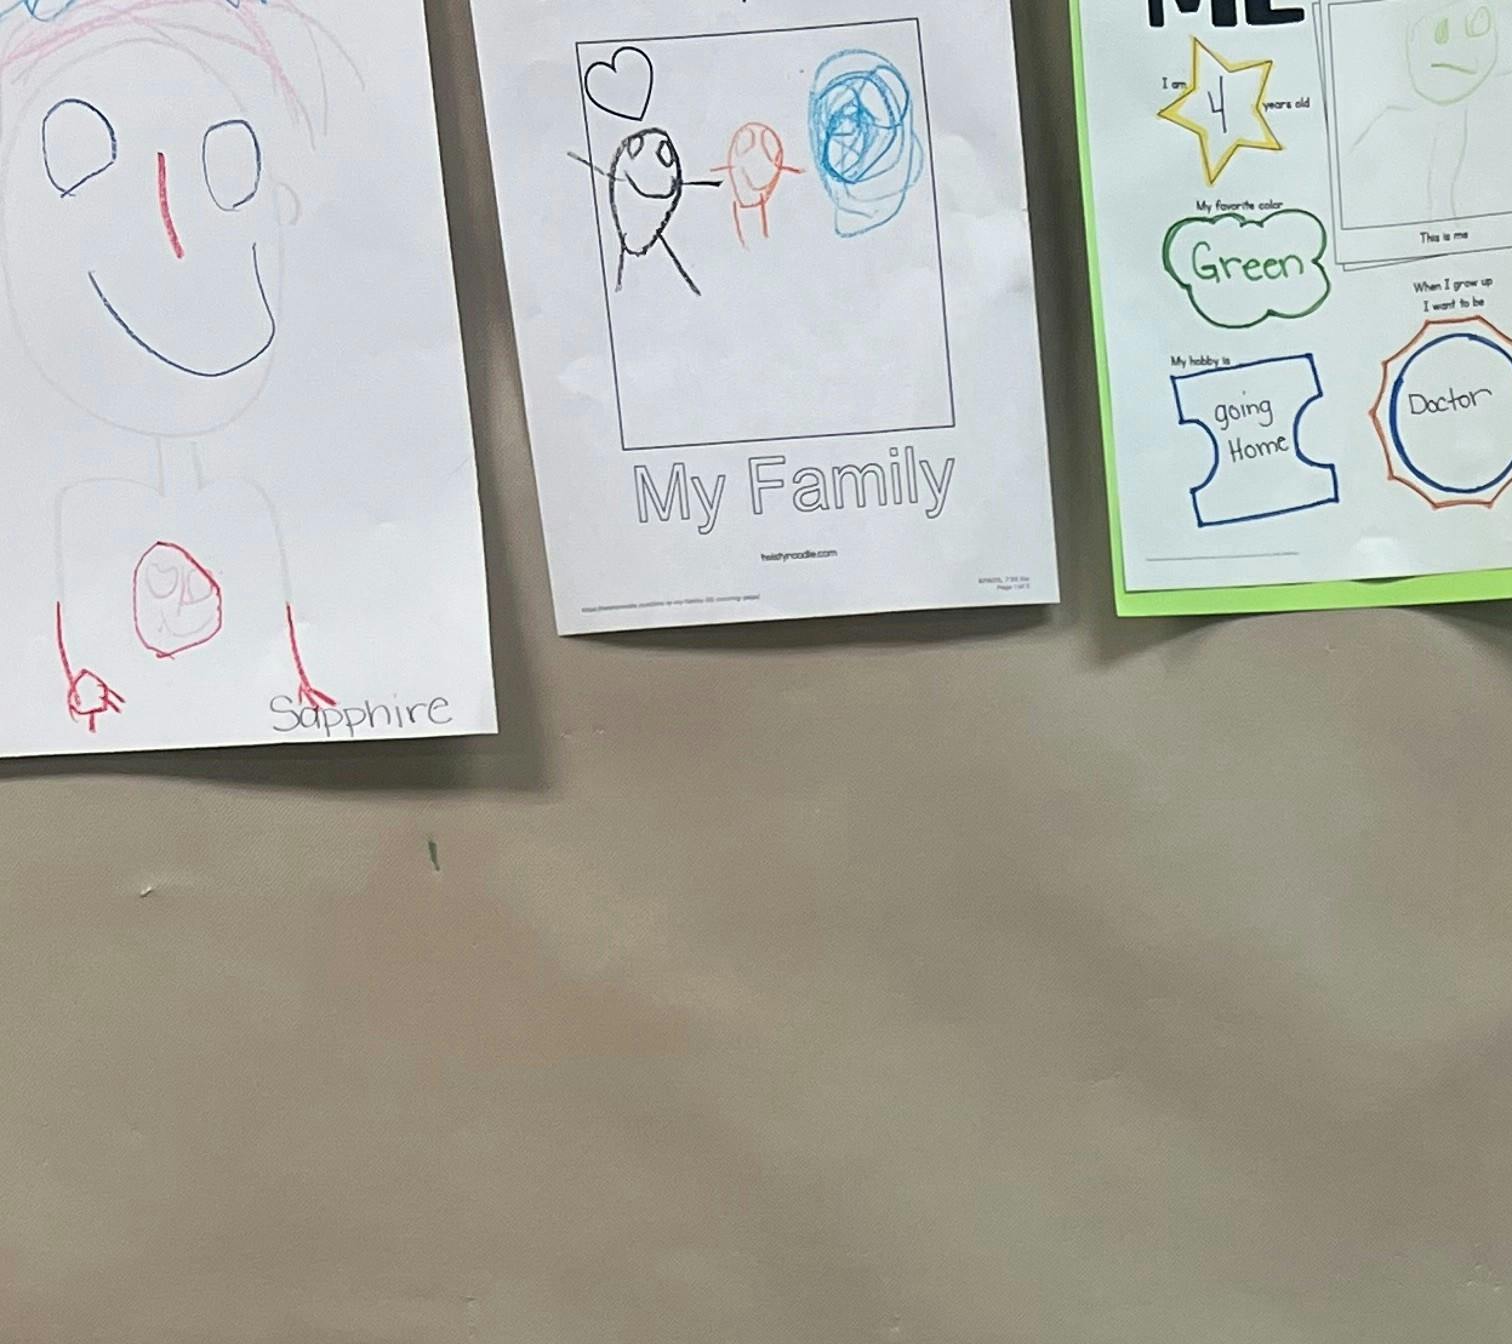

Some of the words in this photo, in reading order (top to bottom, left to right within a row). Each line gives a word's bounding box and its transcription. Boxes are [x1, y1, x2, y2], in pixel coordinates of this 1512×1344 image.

[1162, 77, 1168, 89] I
[1171, 81, 1187, 89] am
[1207, 75, 1227, 134] 4
[1262, 100, 1291, 112] years
[1295, 97, 1310, 108] old
[1196, 201, 1212, 213] My
[1215, 200, 1254, 211] favorite
[1259, 200, 1283, 210] color
[1420, 231, 1440, 243] This
[1443, 232, 1450, 241] is
[1453, 231, 1468, 240] me
[1192, 241, 1304, 283] Green
[1413, 281, 1441, 293] When
[1444, 278, 1450, 290] I
[1453, 280, 1477, 292] grow
[1481, 277, 1493, 288] up
[1423, 300, 1429, 312] I
[1432, 298, 1455, 311] want
[1460, 297, 1469, 308] to
[1473, 296, 1485, 307] be
[1170, 355, 1187, 368] My
[1189, 354, 1219, 367] hobby
[1222, 356, 1231, 366] is
[1214, 390, 1273, 430] going
[1408, 387, 1492, 415] Doctor
[1228, 436, 1289, 462] Home
[634, 462, 726, 535] My
[748, 446, 956, 519] Family
[269, 692, 453, 737] Sapphire
